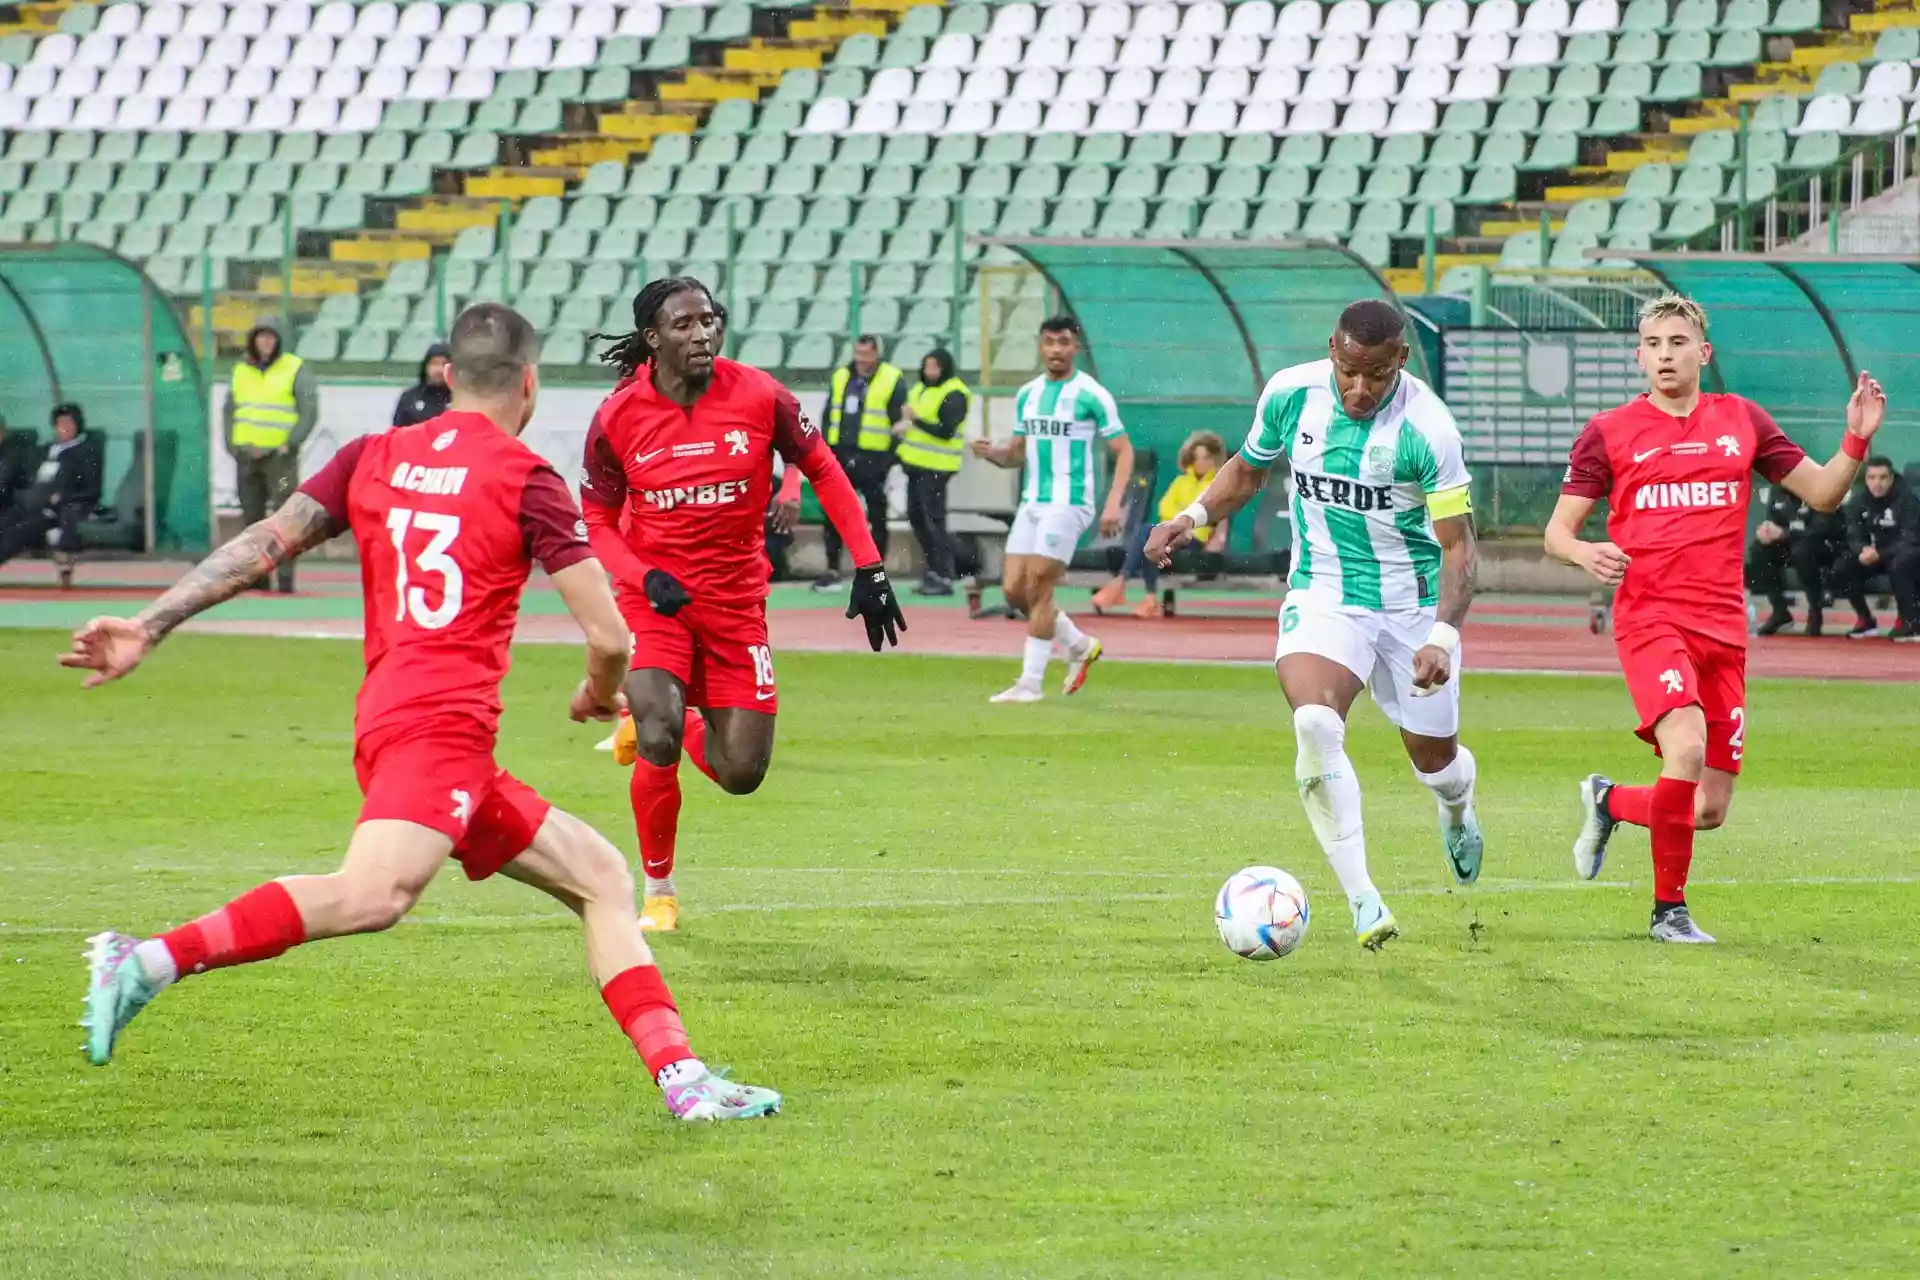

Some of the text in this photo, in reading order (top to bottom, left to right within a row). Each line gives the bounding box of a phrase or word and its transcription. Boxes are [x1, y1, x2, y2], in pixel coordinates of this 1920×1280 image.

[1635, 481, 1739, 510] WINBET
[385, 507, 463, 630] 13
[1282, 605, 1300, 634] 6
[747, 644, 774, 687] 18
